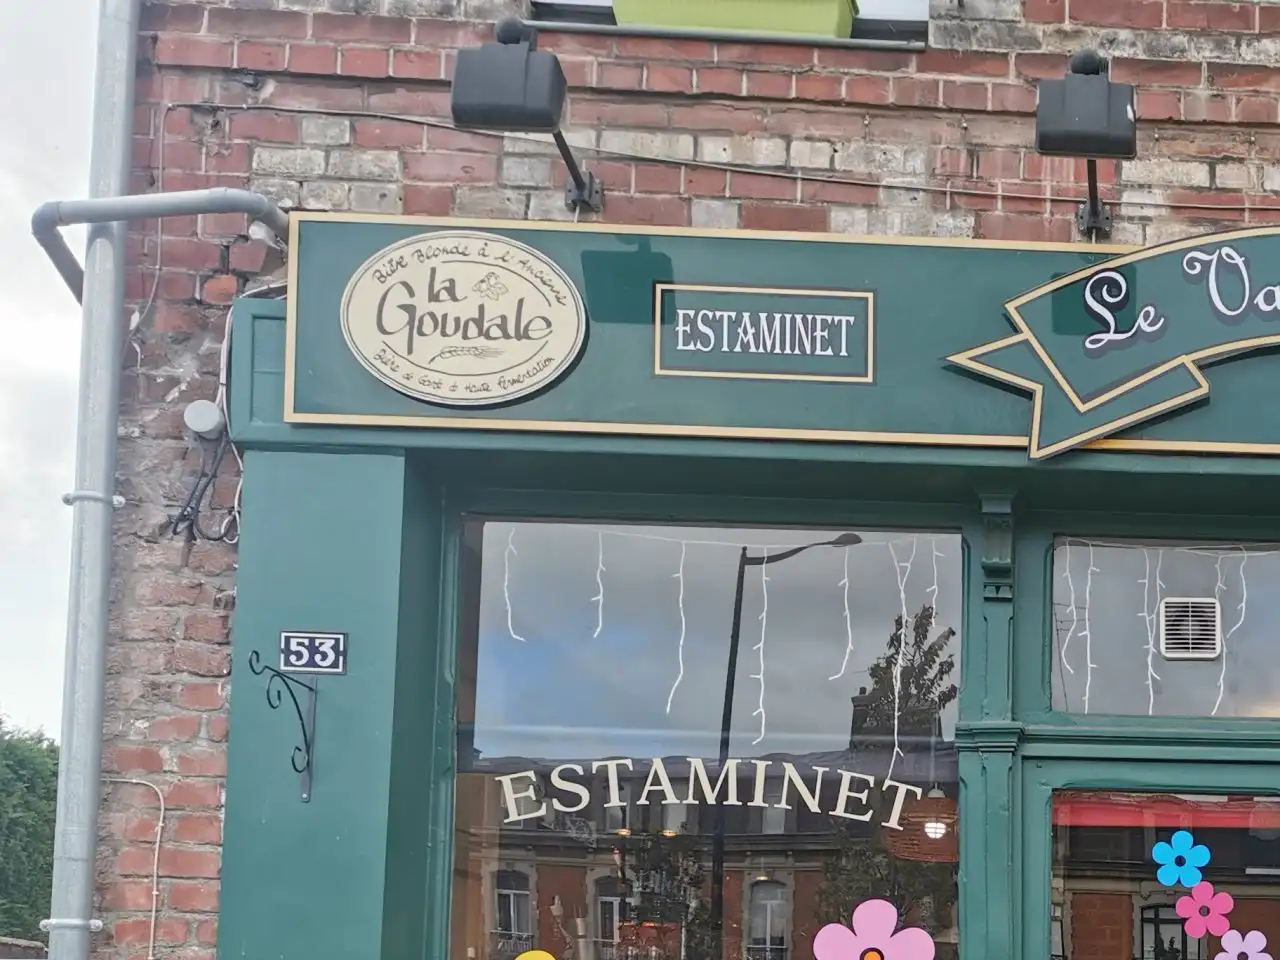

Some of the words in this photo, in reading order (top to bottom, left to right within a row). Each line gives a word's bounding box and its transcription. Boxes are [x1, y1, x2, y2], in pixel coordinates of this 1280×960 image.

[372, 255, 408, 285] Bière
[411, 244, 470, 263] Blonde
[477, 242, 489, 258] à
[428, 266, 467, 303] la
[376, 281, 553, 356] Goudale
[675, 309, 854, 356] ESTAMINET
[1083, 271, 1164, 349] Le
[373, 349, 400, 372] Bière
[402, 373, 414, 381] de
[464, 383, 492, 393] Haute
[289, 638, 336, 667] 53
[494, 757, 922, 831] ESTAMINET
